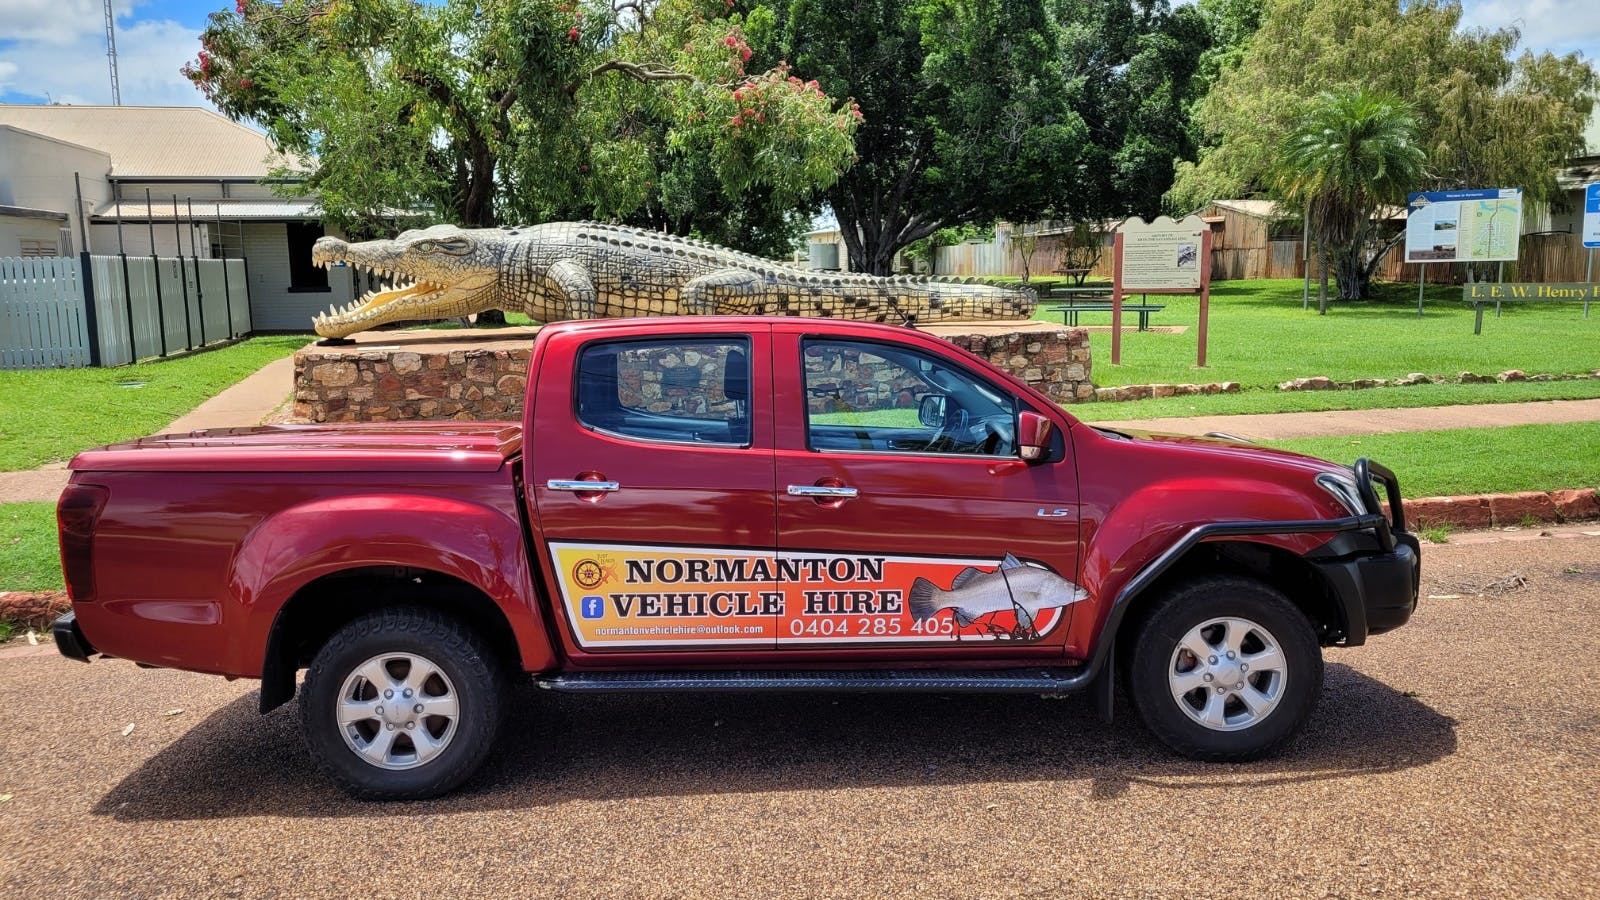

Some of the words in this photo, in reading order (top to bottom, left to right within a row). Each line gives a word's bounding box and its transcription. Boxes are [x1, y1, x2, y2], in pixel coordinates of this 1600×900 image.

[1471, 286, 1485, 298] L.
[1491, 286, 1505, 298] E.
[1512, 286, 1532, 298] W.
[1538, 285, 1588, 300] Henry
[1037, 508, 1069, 517] LS
[625, 557, 885, 584] NORMANTON
[609, 592, 785, 618] VEHICLE
[803, 590, 903, 615] HIRE
[595, 624, 763, 636] normantonvehiclehire@outlook.com
[790, 618, 848, 636] 0404
[857, 617, 901, 635] 285
[910, 616, 953, 634] 405
